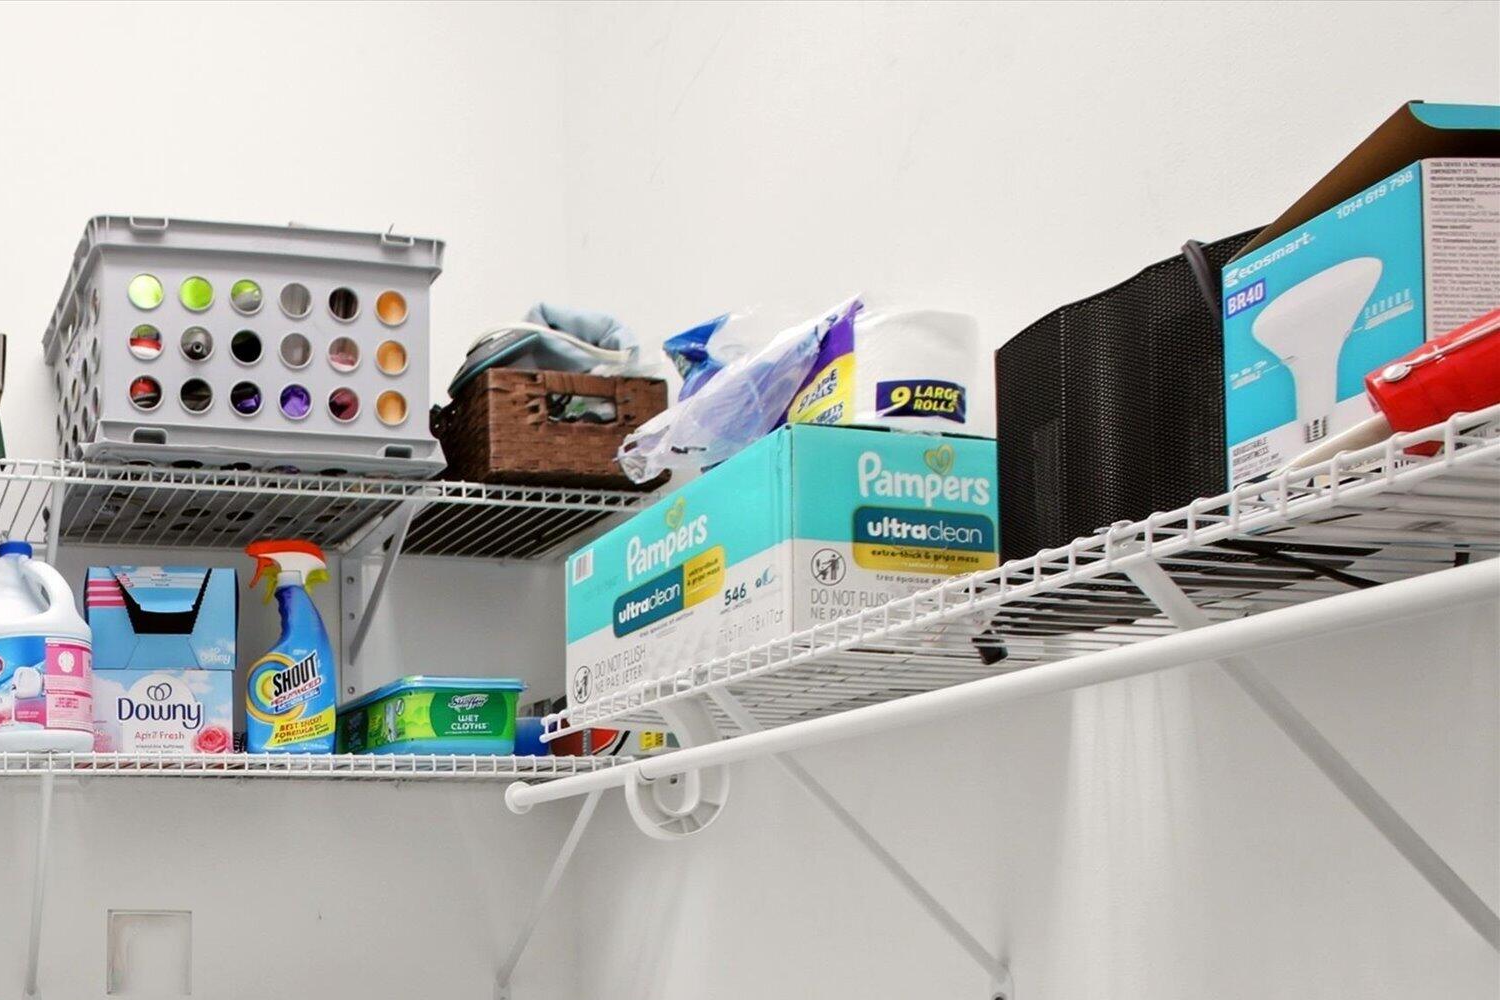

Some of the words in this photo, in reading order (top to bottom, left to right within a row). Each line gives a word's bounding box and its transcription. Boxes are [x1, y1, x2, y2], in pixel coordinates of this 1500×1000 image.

[1336, 198, 1364, 220] 1014
[1365, 184, 1388, 205] 619
[1237, 231, 1312, 279] ecosmart
[1227, 282, 1265, 316] BR40
[890, 386, 912, 408] 9
[914, 384, 960, 403] LARGE
[913, 398, 957, 414] ROLLS
[858, 451, 991, 509] Pampers
[866, 516, 983, 545] ultraclean
[626, 513, 708, 583] Pampers
[618, 583, 681, 624] ultraclean
[724, 582, 747, 606] 546
[810, 588, 828, 605] DO
[832, 589, 855, 606] NOT
[810, 607, 826, 619] NE
[273, 652, 316, 697] SHOUT
[118, 697, 201, 730] Downy
[458, 714, 480, 722] WET
[159, 730, 185, 740] Fresh
